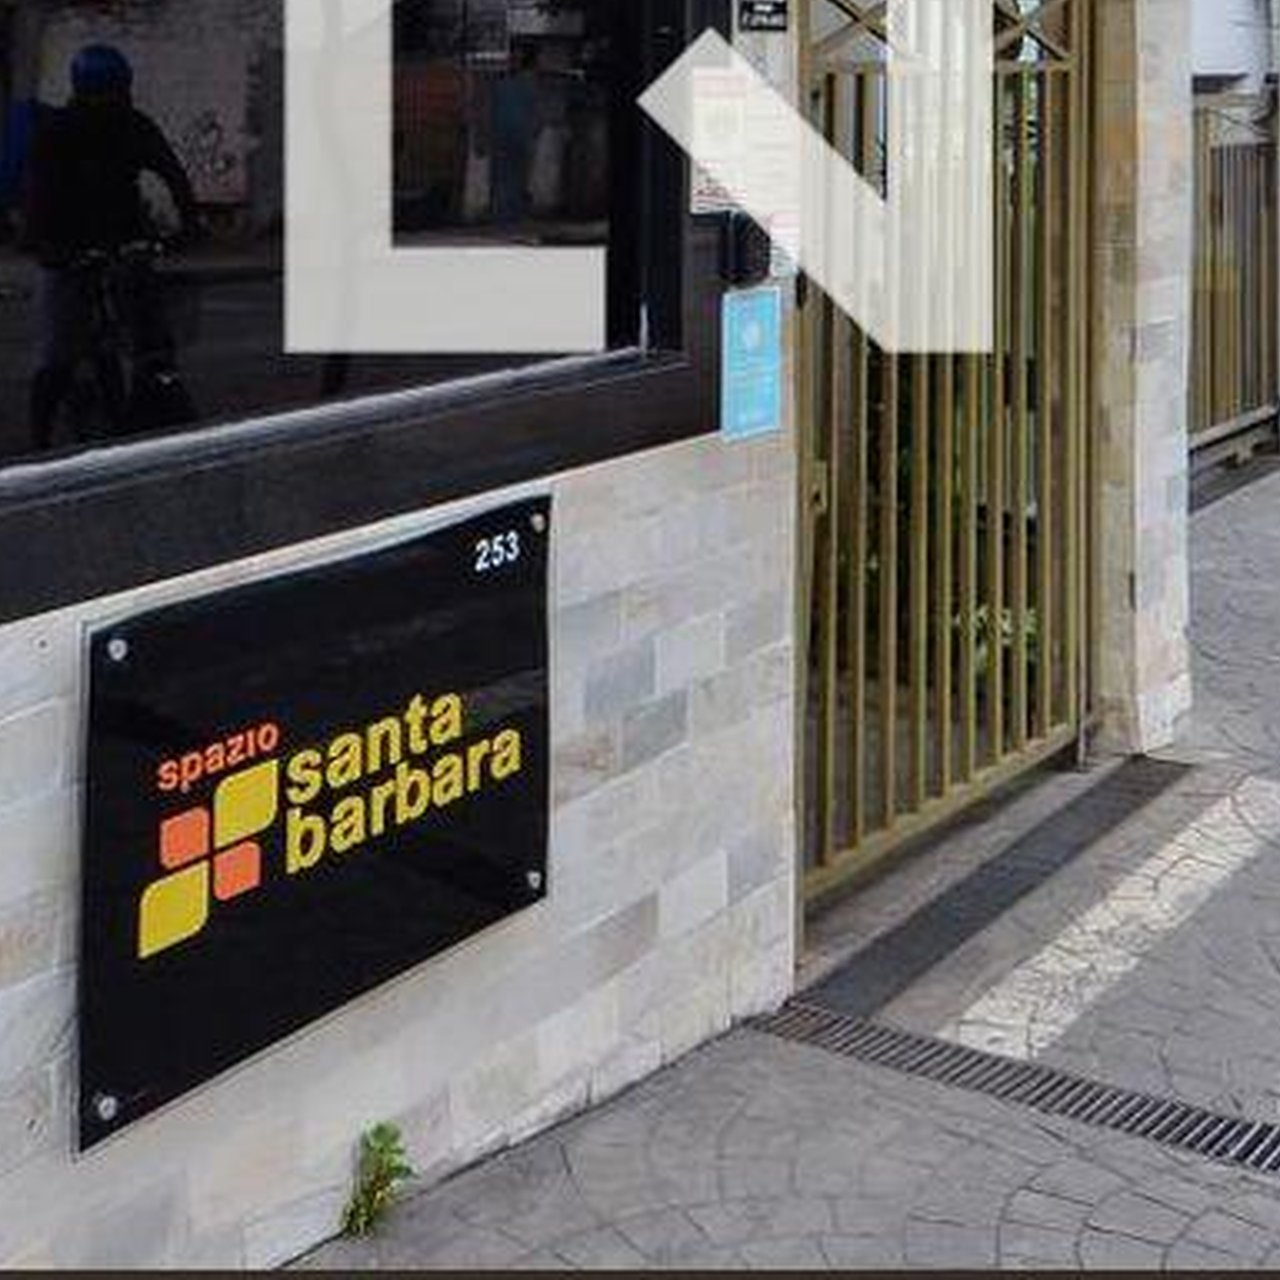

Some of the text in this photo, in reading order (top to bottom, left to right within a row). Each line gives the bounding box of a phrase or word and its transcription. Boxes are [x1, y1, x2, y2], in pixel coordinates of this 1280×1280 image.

[475, 530, 520, 572] 253
[157, 723, 279, 793] spazio
[286, 693, 462, 804] santa
[286, 729, 521, 874] barbara
